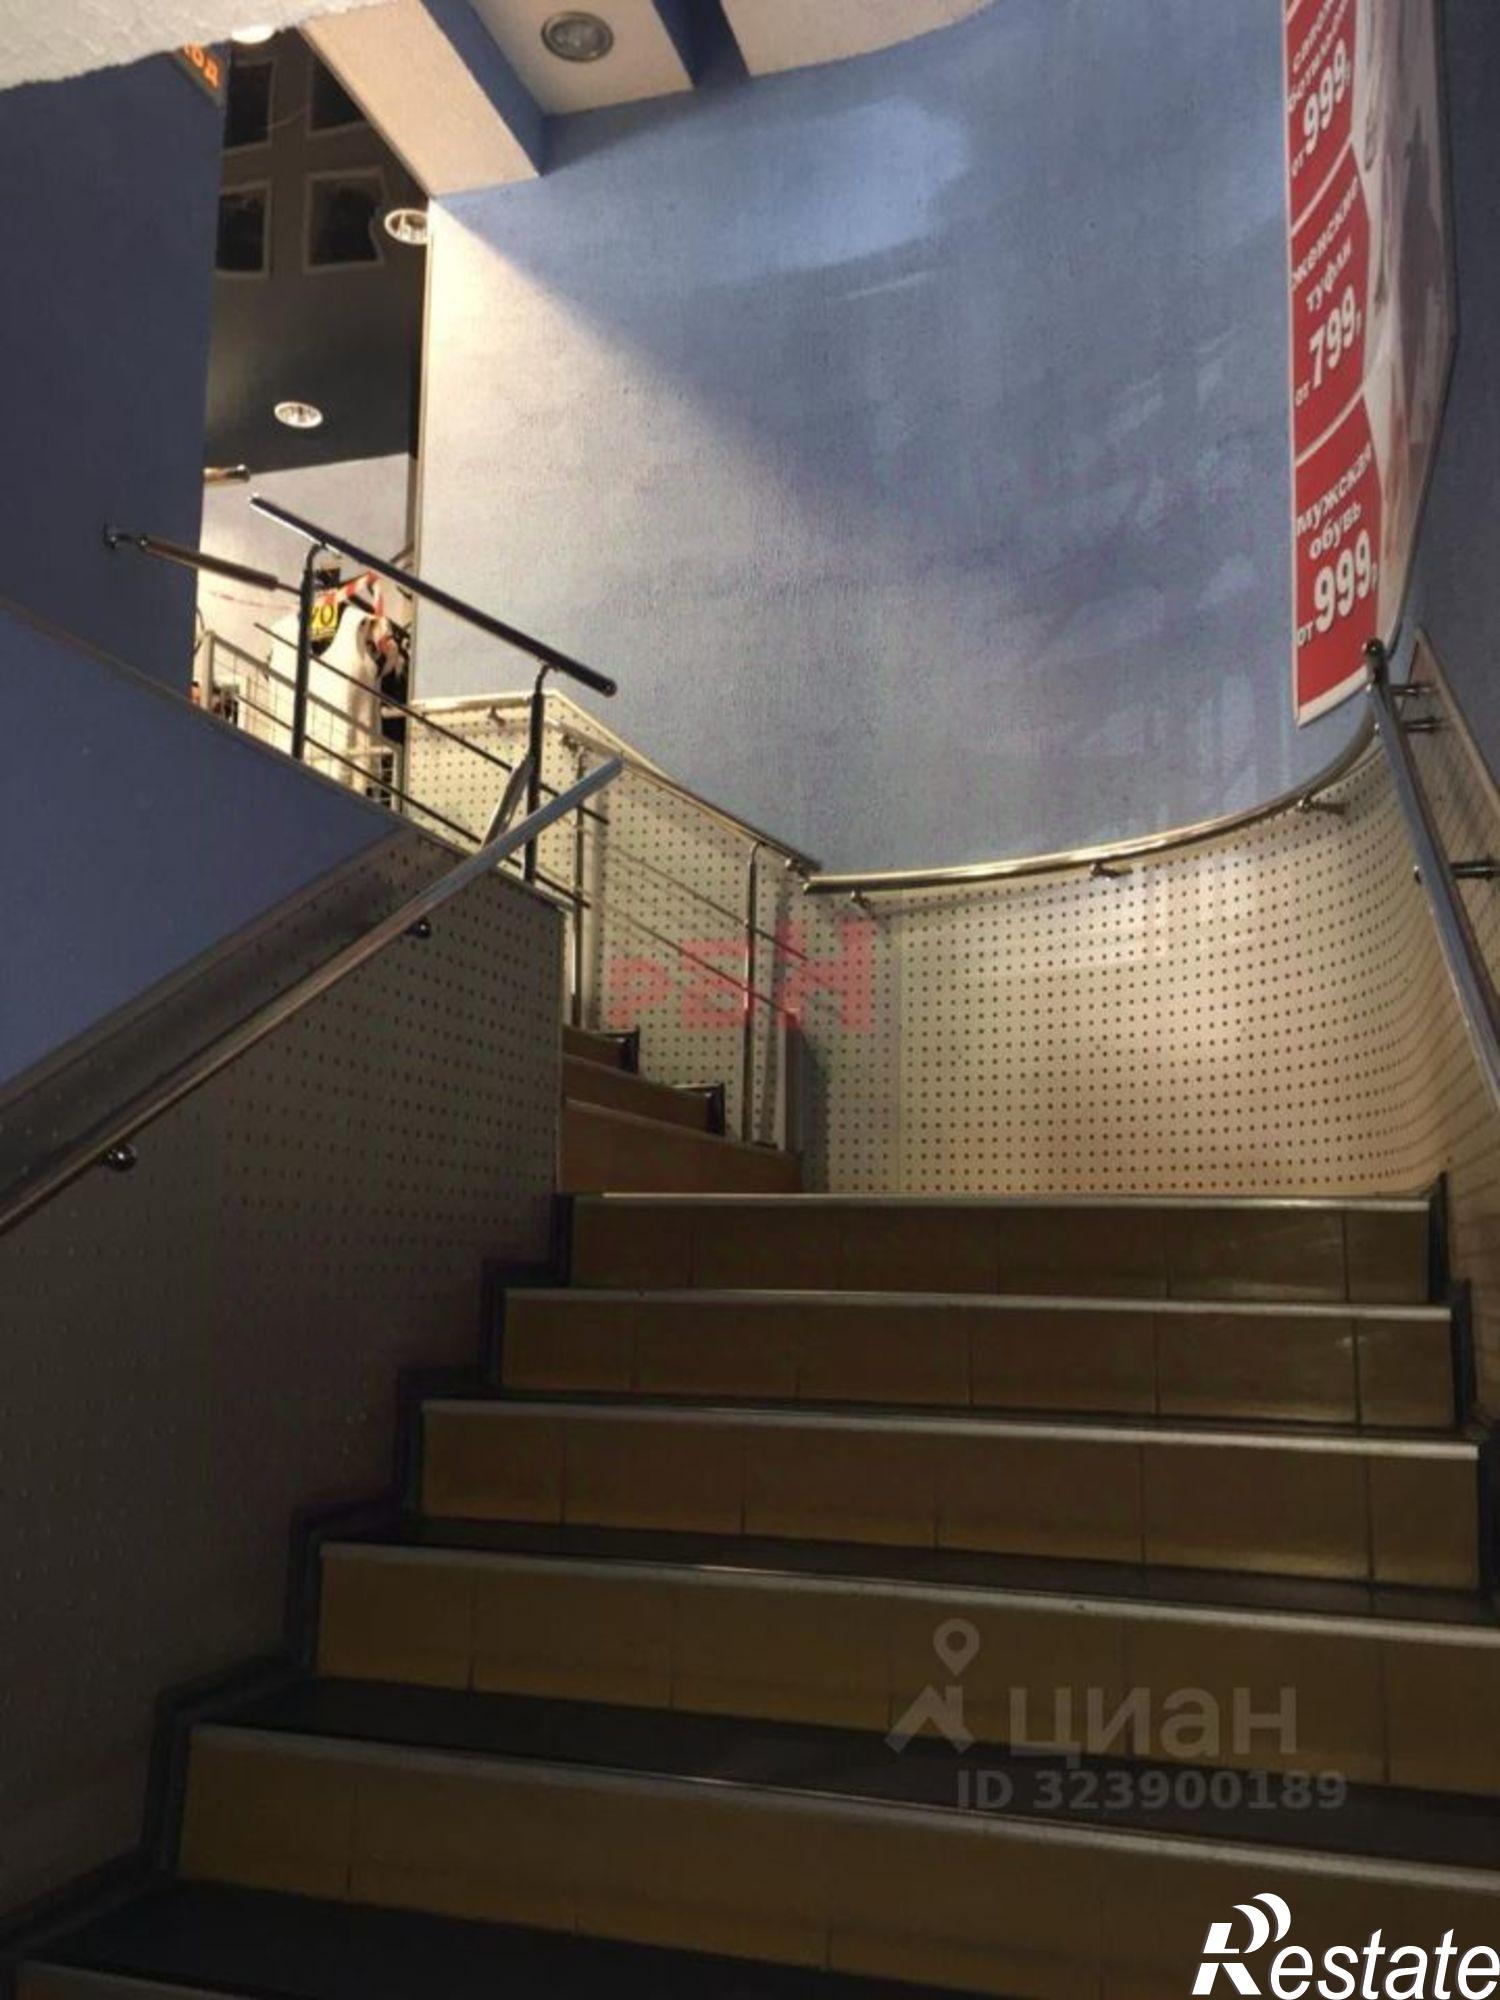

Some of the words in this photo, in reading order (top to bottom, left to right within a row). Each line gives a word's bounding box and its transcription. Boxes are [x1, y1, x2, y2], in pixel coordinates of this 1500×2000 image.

[1303, 37, 1346, 155] 999
[1309, 285, 1355, 389] 799
[1296, 441, 1372, 536] мужская
[1309, 502, 1362, 561] обувь
[1298, 620, 1314, 648] от
[1314, 529, 1371, 633] 999
